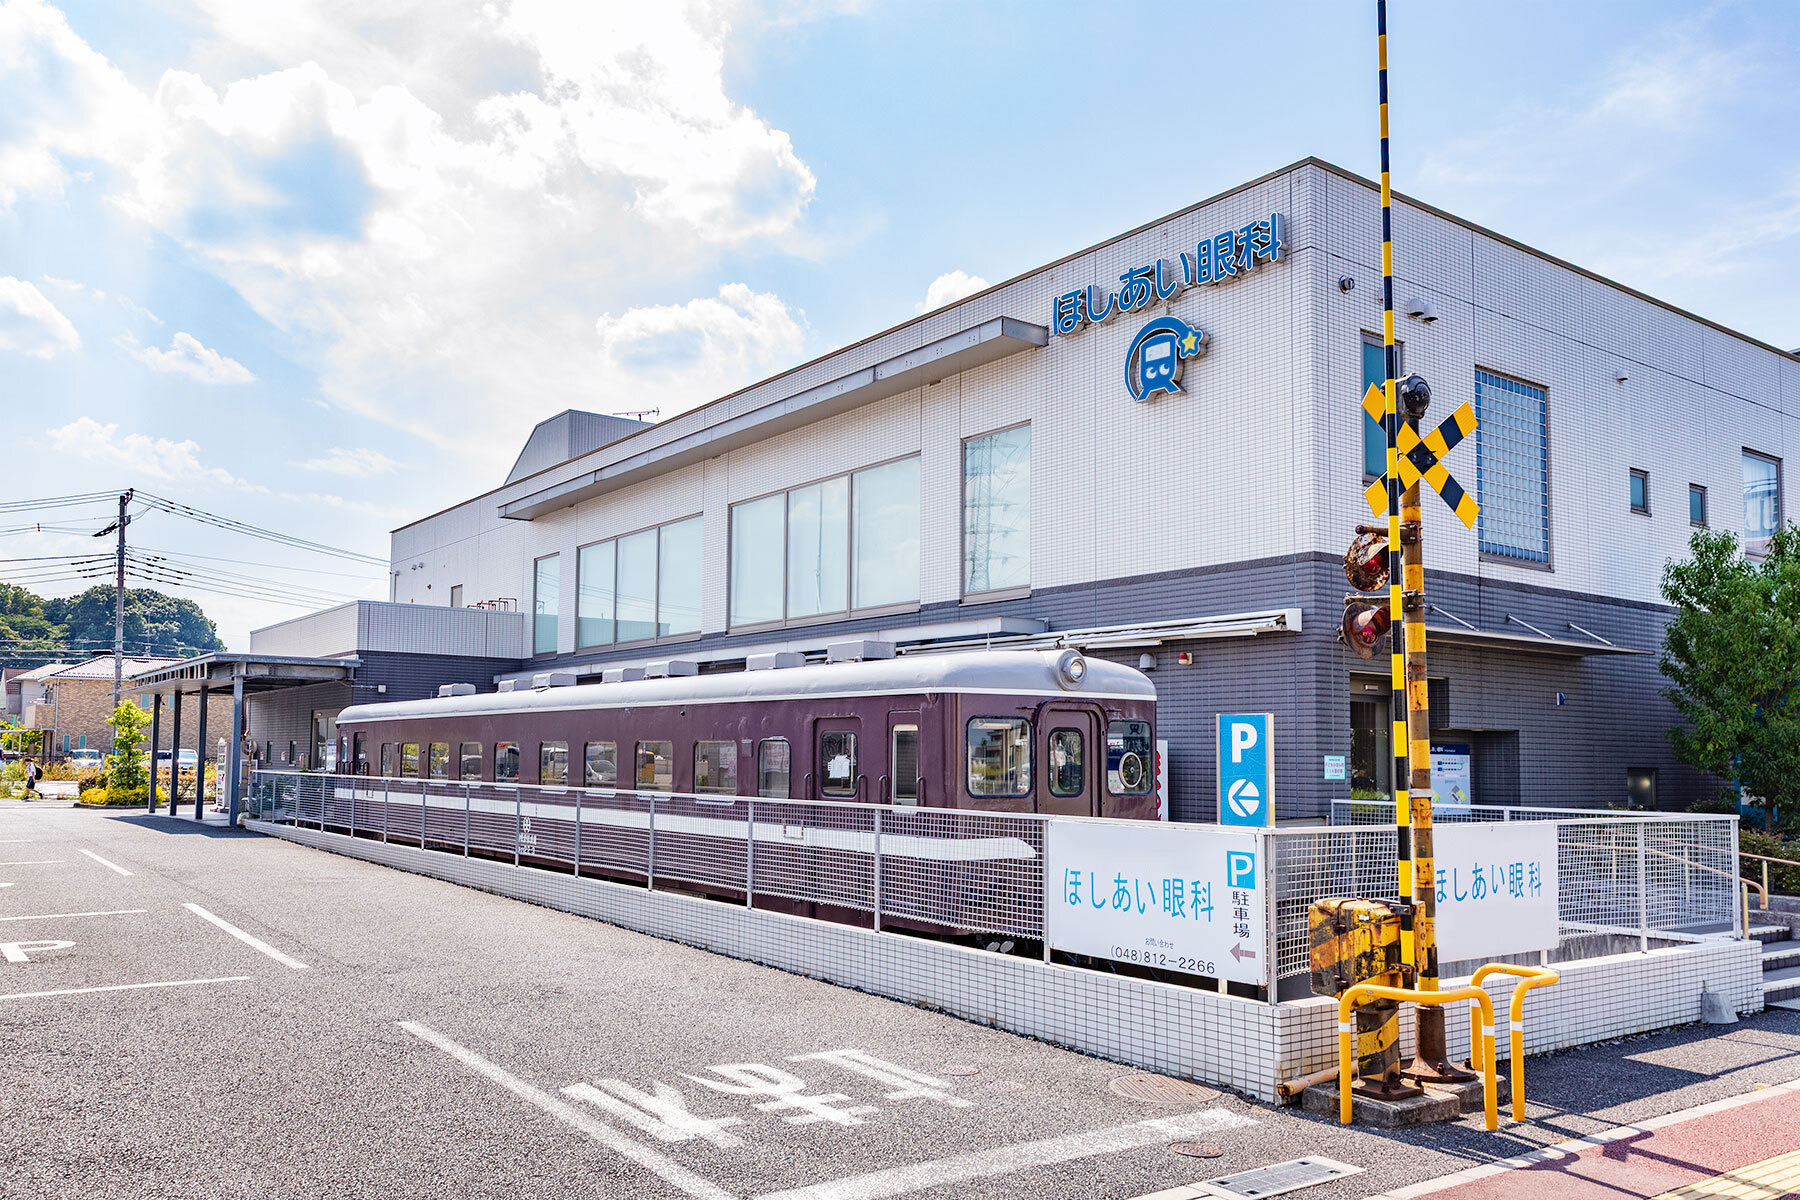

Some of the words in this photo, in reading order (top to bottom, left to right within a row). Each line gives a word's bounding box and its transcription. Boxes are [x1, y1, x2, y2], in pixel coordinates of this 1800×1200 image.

[1052, 212, 1284, 336] ほしあい眼科
[1231, 722, 1258, 763] P
[1230, 854, 1253, 886] P
[1063, 867, 1215, 922] ほしあい眼科
[1231, 890, 1251, 939] 駐車場
[1110, 944, 1216, 975] (048)812-2266
